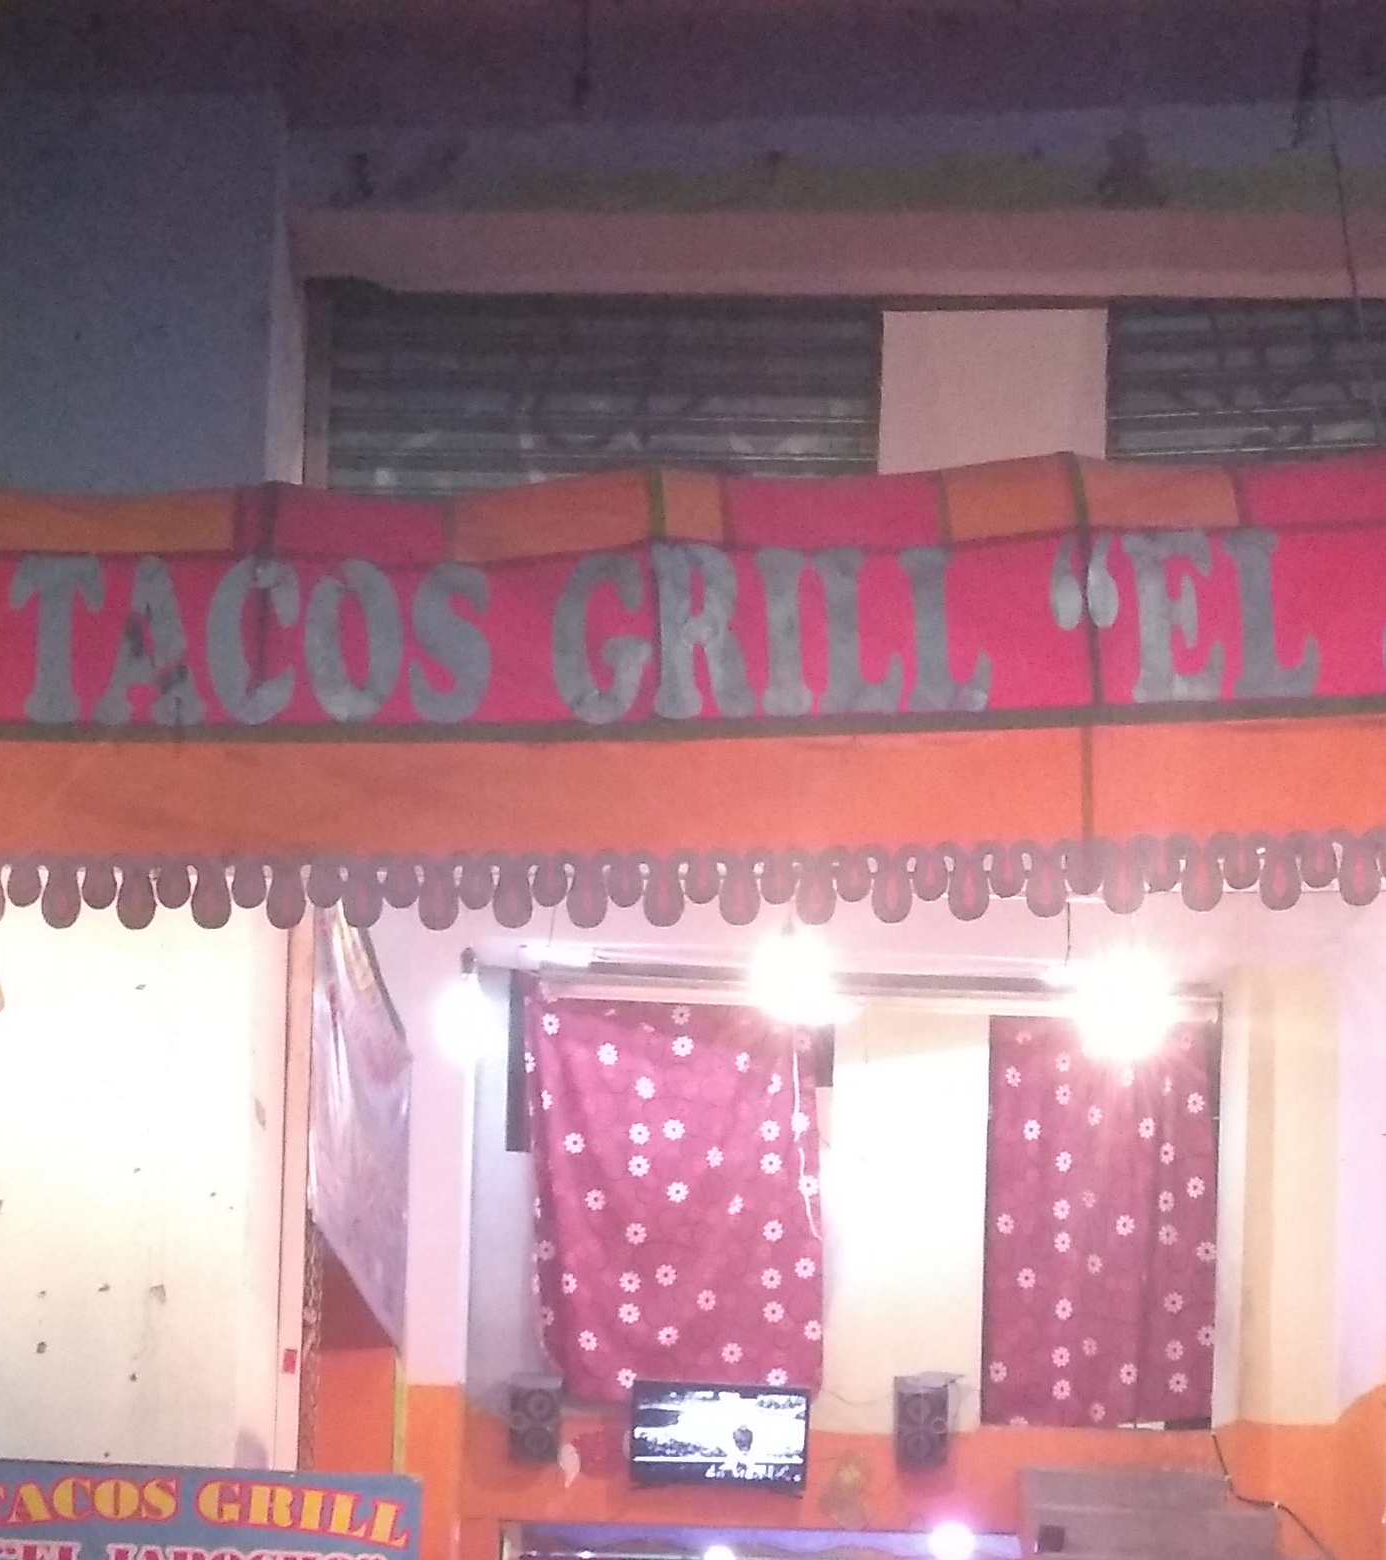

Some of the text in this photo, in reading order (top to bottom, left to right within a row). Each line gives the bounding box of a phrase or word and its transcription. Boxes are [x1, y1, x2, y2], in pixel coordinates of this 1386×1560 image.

[8, 552, 492, 725] TACOS
[552, 540, 992, 721] GRILL
[196, 1479, 410, 1549] GRILL
